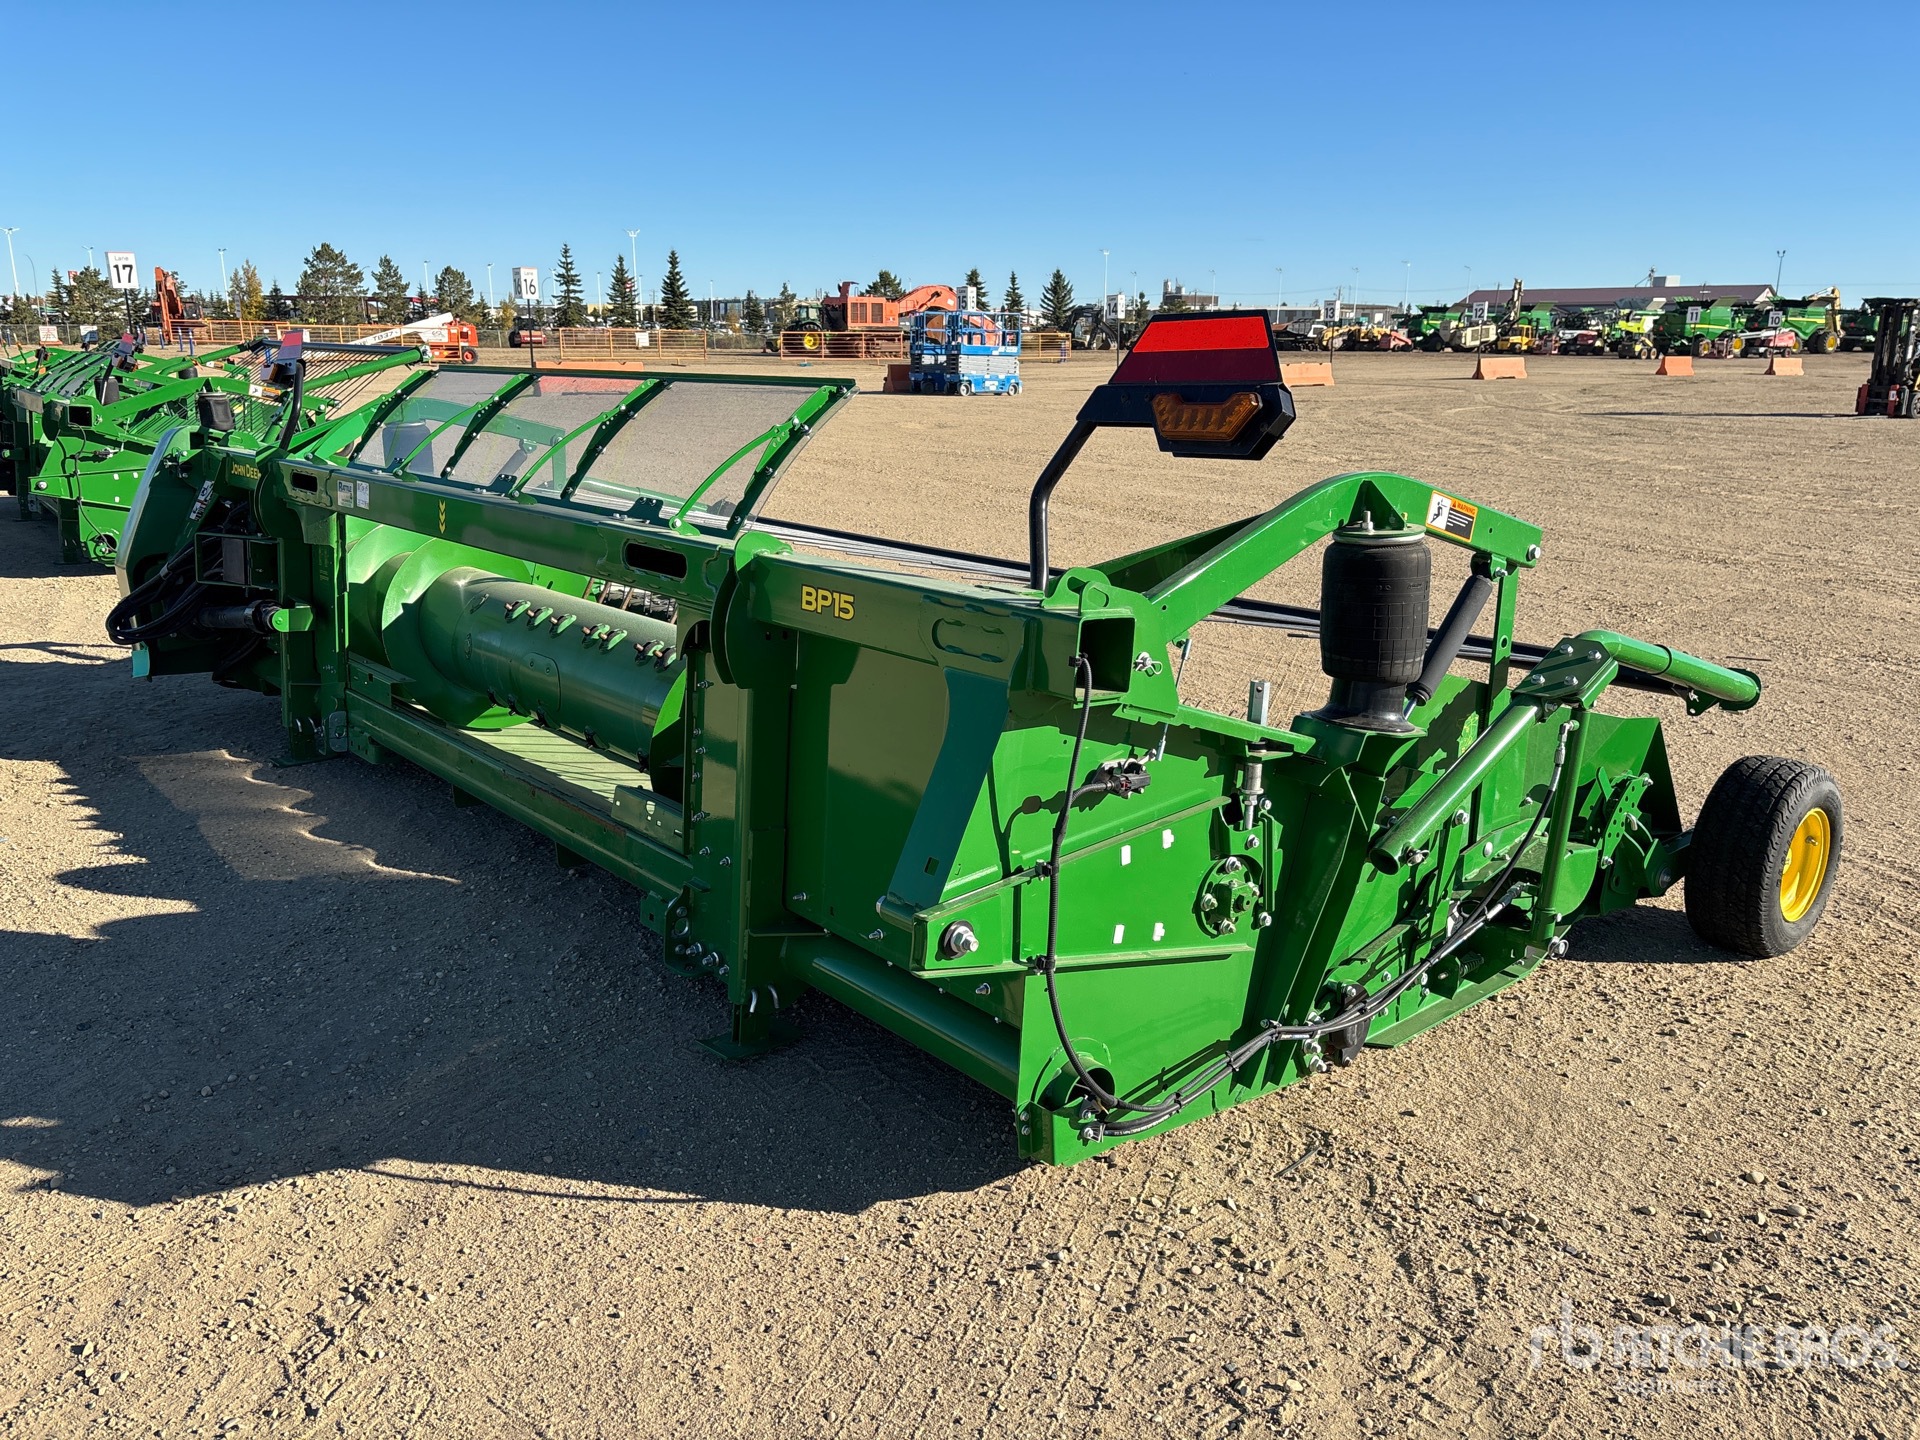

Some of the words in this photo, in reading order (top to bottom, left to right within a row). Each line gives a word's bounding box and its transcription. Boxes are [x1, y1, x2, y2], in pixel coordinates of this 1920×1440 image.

[113, 264, 133, 283] 17
[523, 279, 536, 295] 16
[958, 296, 967, 309] 15
[1108, 303, 1117, 316] 14
[1325, 308, 1335, 319] 13
[1475, 308, 1484, 319] 12
[1690, 312, 1699, 321] 11
[1771, 316, 1780, 325] 10
[231, 461, 245, 476] JOHN
[1457, 503, 1476, 515] WARNING
[801, 585, 855, 620] BP15
